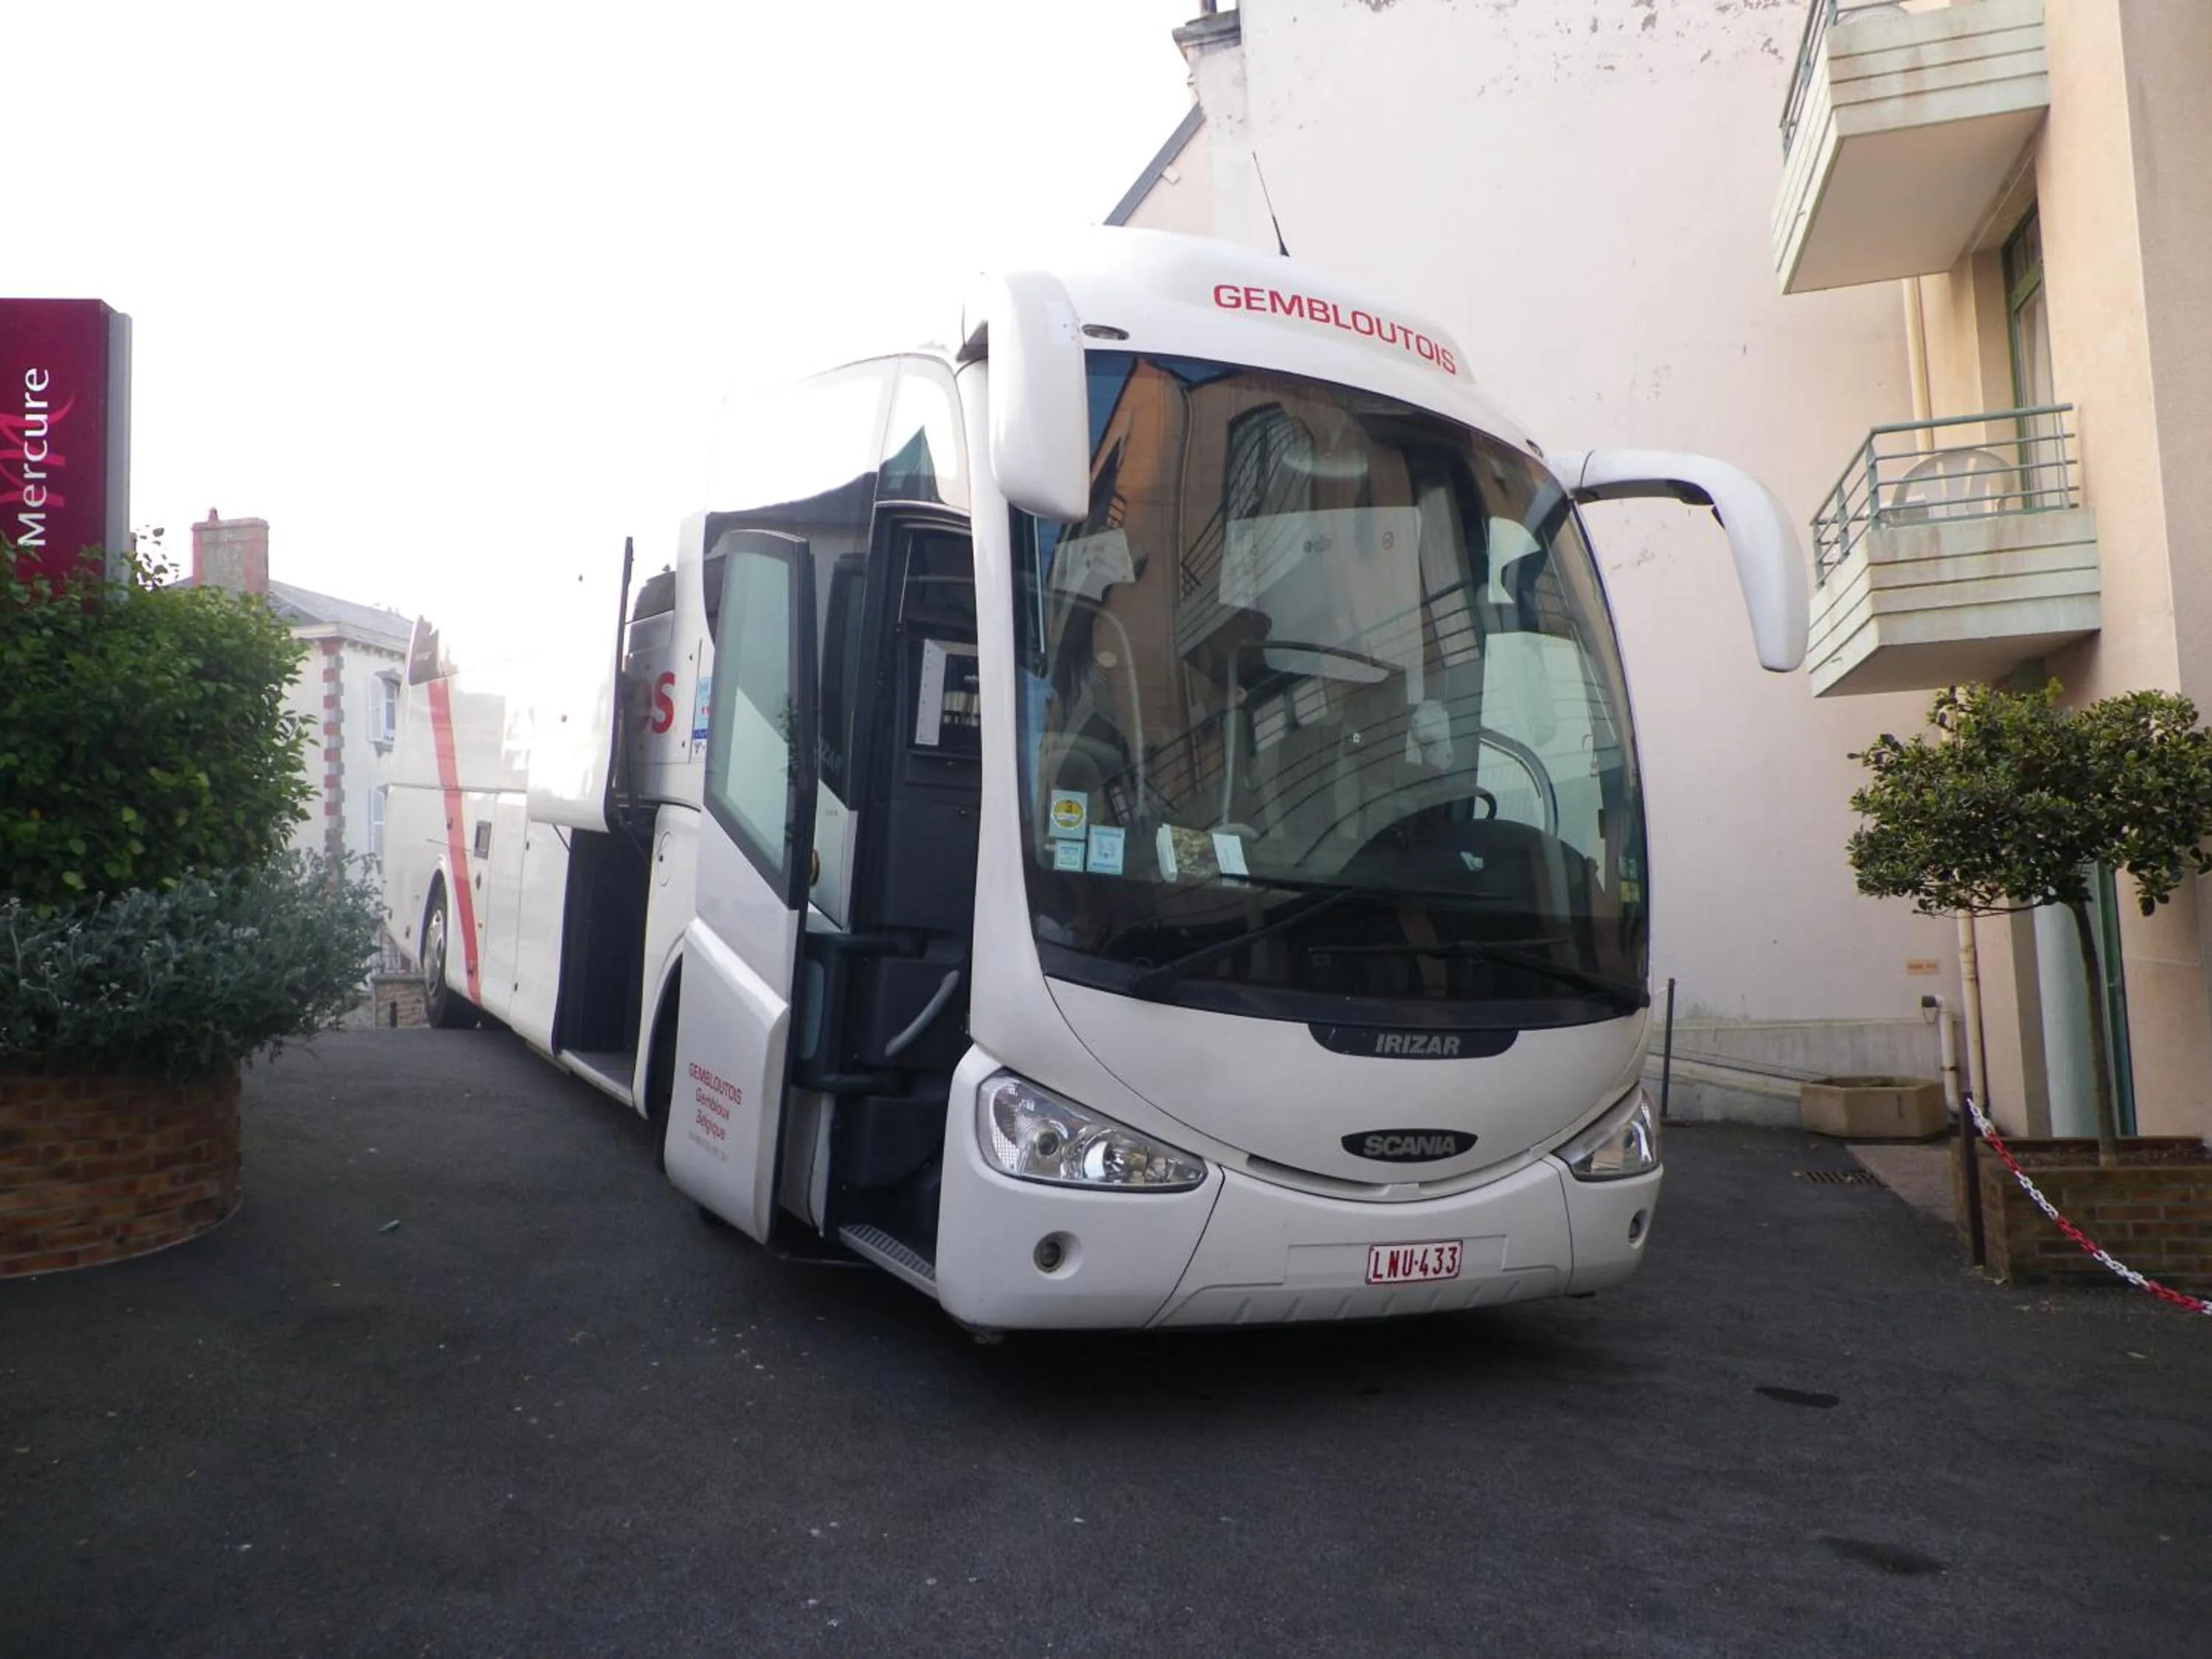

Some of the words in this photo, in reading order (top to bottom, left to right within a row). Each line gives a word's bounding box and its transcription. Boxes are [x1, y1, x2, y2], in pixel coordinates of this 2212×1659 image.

[1213, 284, 1457, 375] GEMBLOUTOIS
[18, 367, 50, 548] Mercure
[1375, 1033, 1461, 1055] IRIZAR
[688, 1062, 743, 1106] GEMBLOUTOIS
[1363, 1135, 1457, 1156] SCANIA
